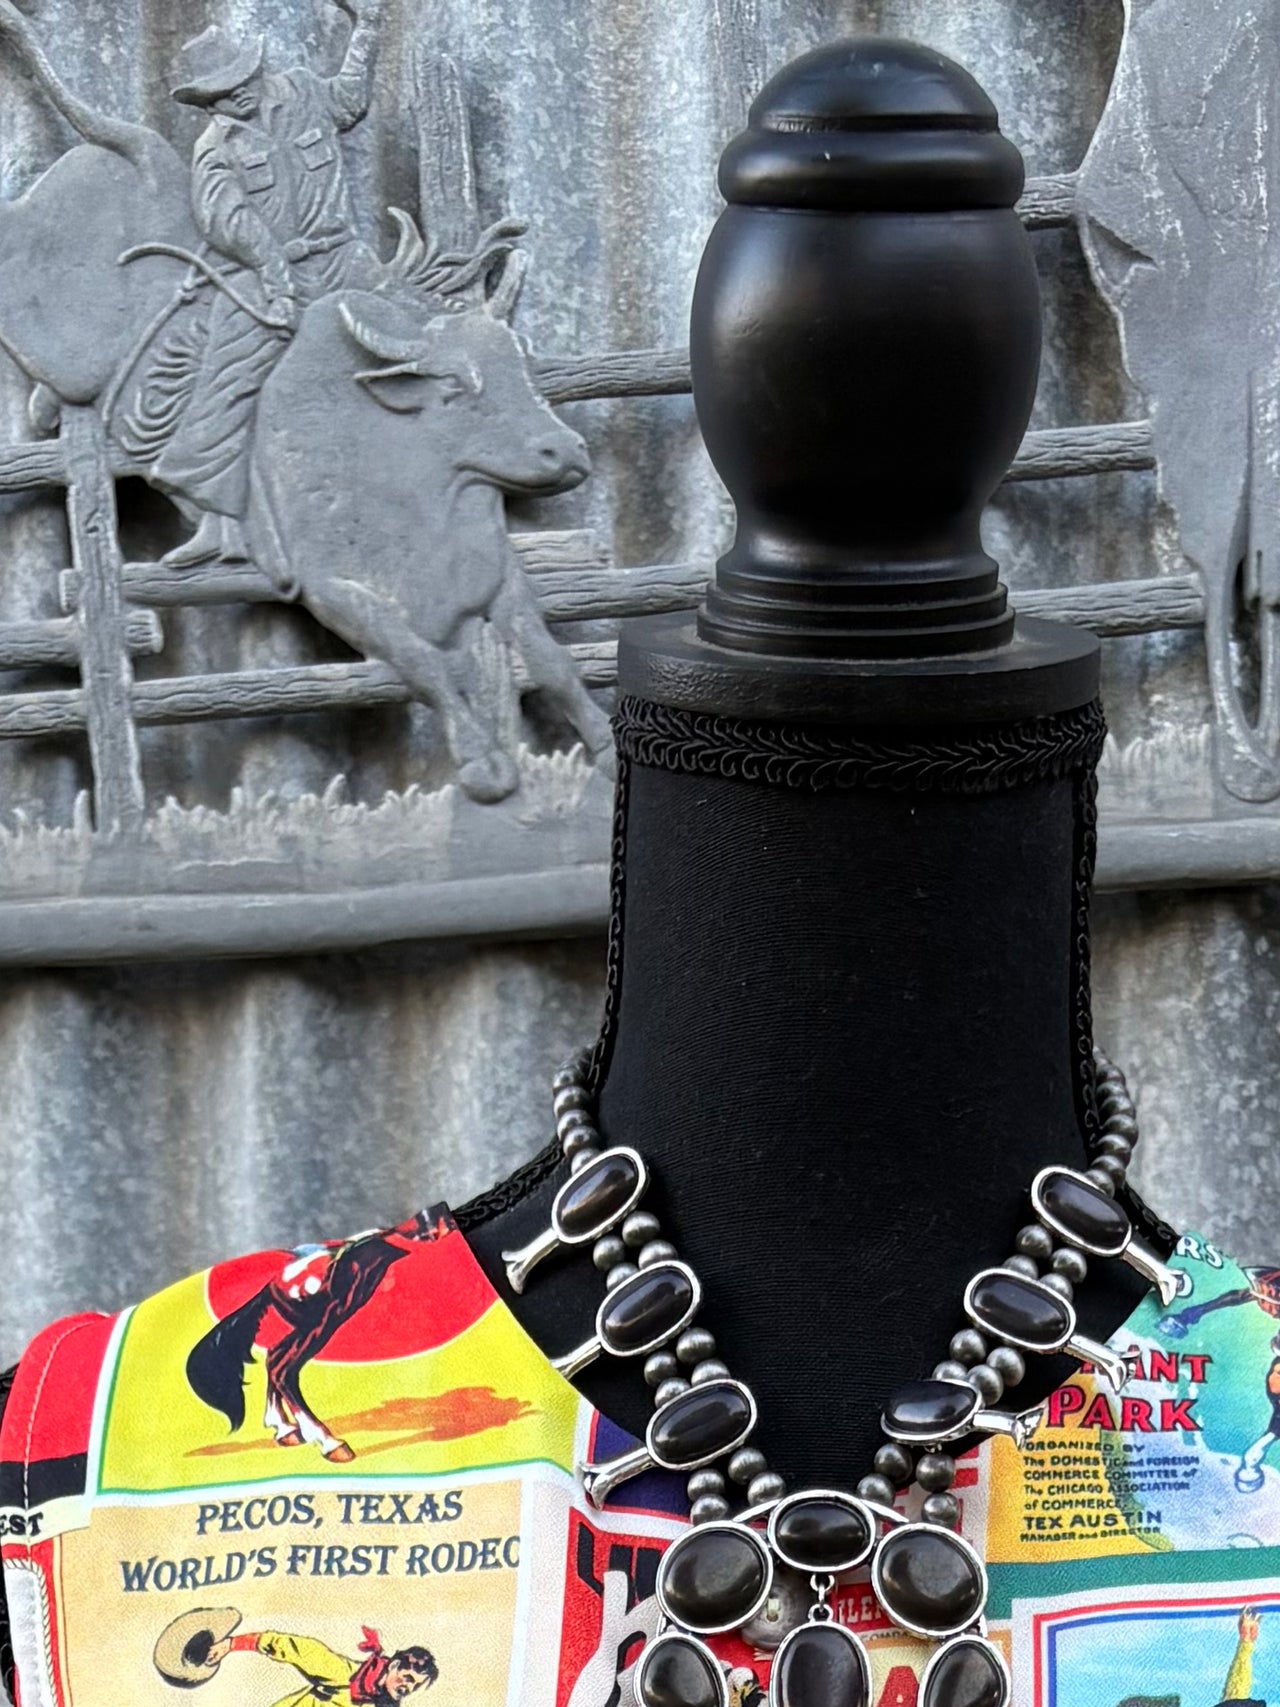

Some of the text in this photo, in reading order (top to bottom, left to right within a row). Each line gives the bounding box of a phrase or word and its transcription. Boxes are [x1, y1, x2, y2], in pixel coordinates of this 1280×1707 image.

[1045, 1384, 1204, 1433] PARK
[1024, 1440, 1146, 1453] ORGANIZED BY
[1023, 1455, 1045, 1467] The
[1050, 1455, 1121, 1468] DOMESTIC
[1146, 1455, 1200, 1468] FOREIGN
[1023, 1469, 1100, 1481] COMMERCE
[1104, 1469, 1179, 1480] COMMITTEE
[1047, 1483, 1103, 1496] CHICAGO
[1106, 1481, 1191, 1494] ASSOCIATION
[1024, 1498, 1038, 1511] of
[195, 1490, 464, 1536] PECOS, TEXAS
[1023, 1510, 1163, 1531] TEX AUSTIN
[1019, 1531, 1077, 1543] MANAGER
[1099, 1526, 1161, 1538] DIRECTOR
[120, 1545, 279, 1594] WORLD'S
[285, 1542, 399, 1579] FIRST
